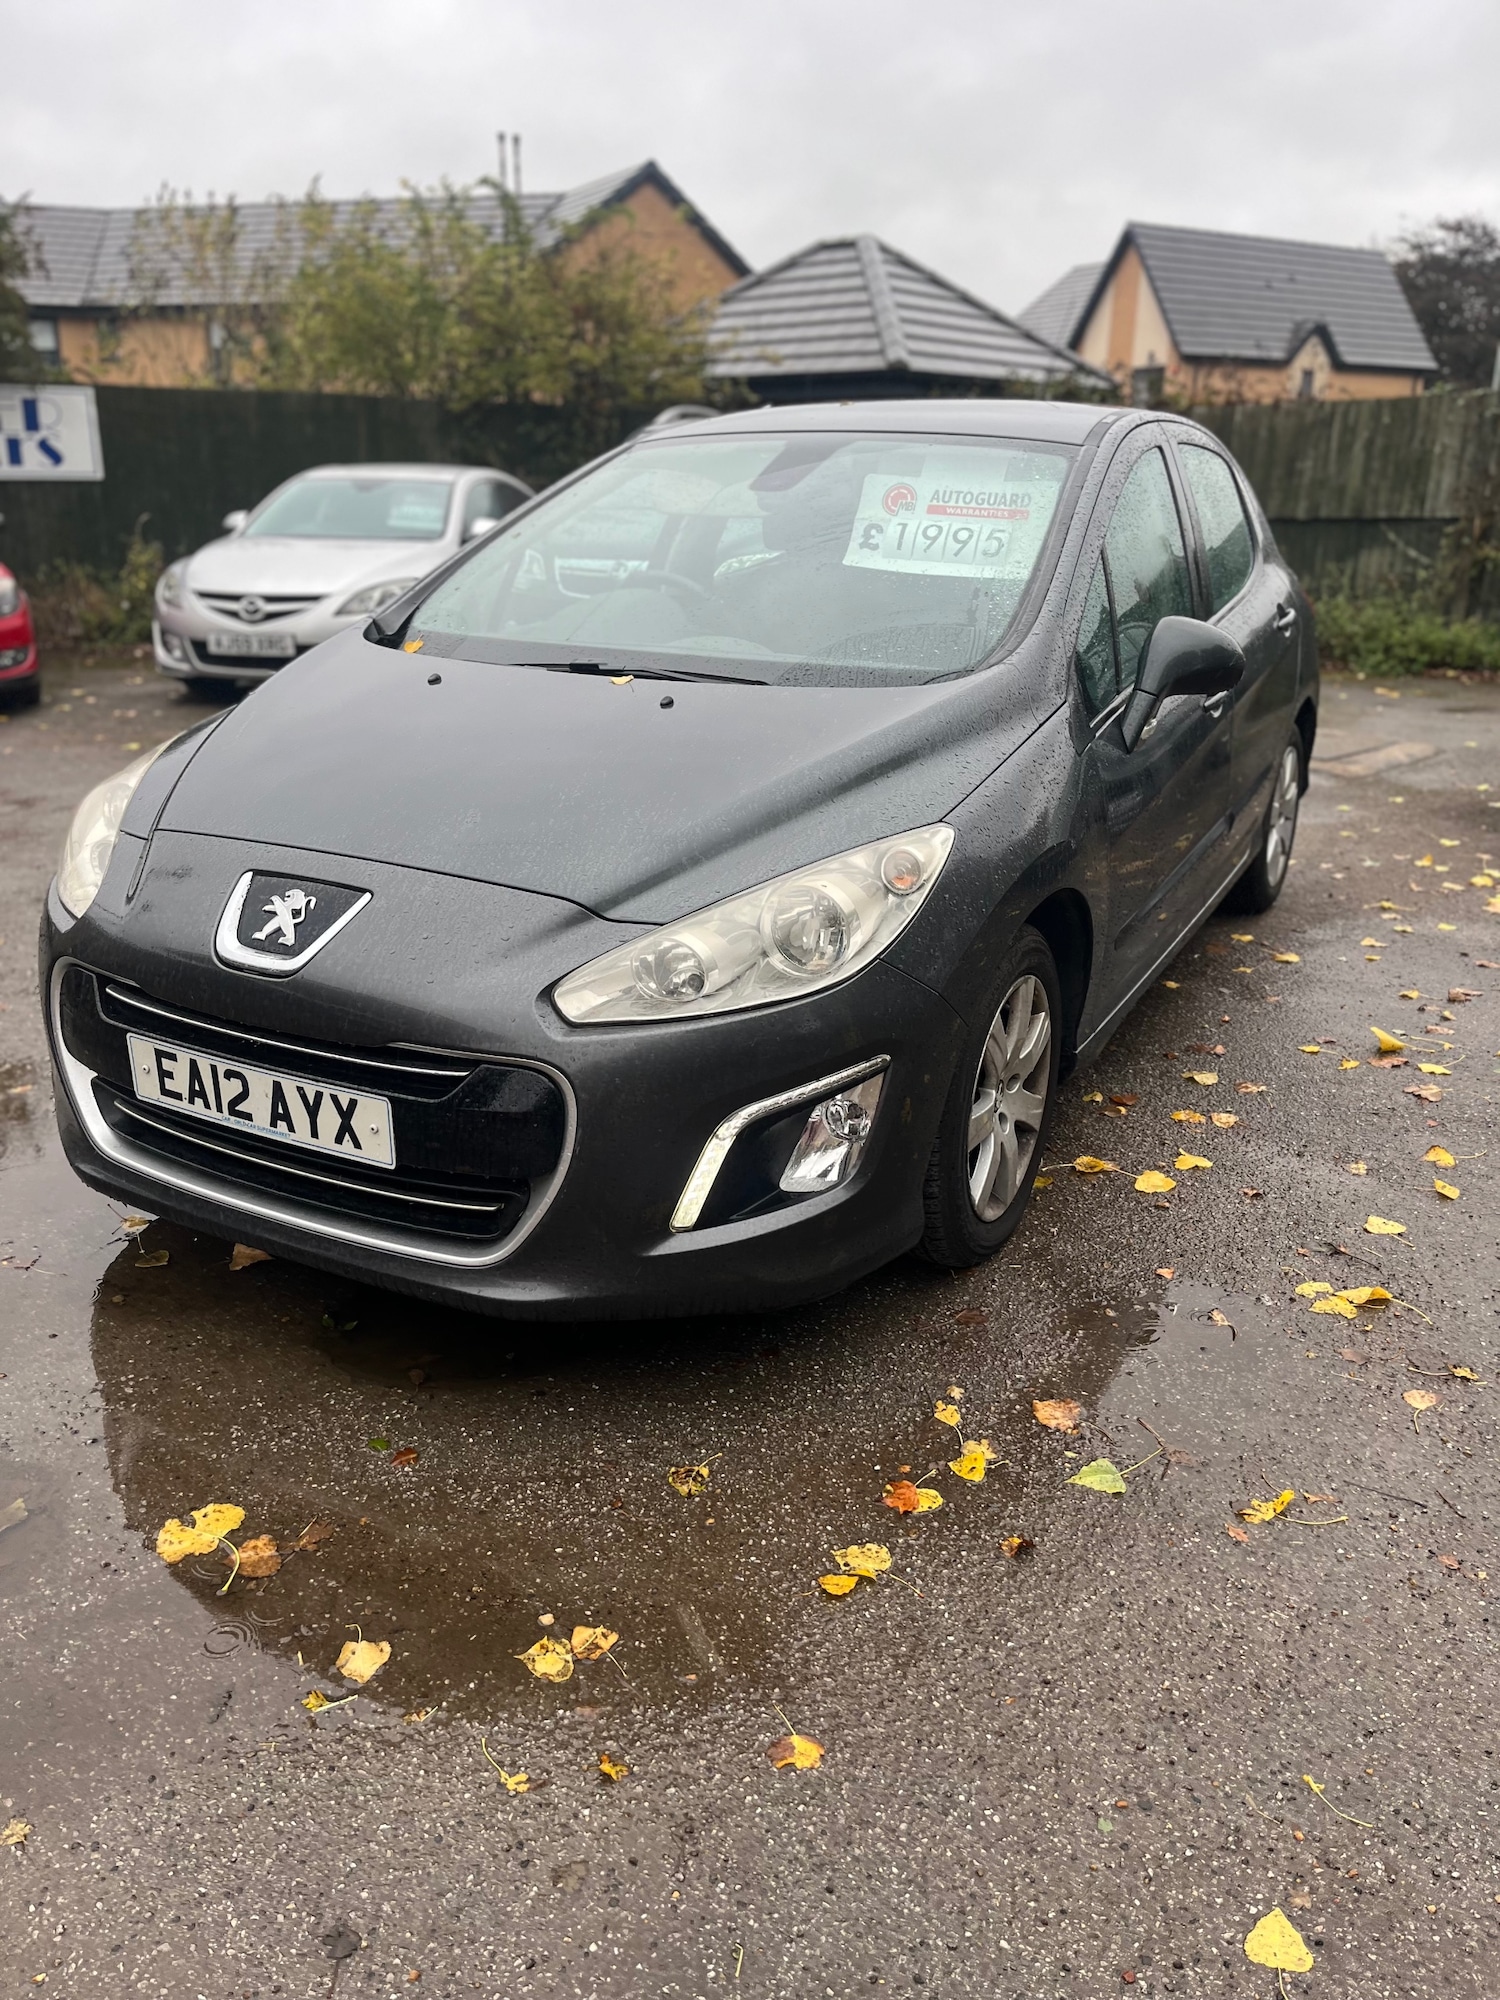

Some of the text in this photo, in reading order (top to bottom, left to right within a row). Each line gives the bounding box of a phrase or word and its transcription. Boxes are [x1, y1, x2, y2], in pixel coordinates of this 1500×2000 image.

[929, 488, 1032, 508] AUTOGUARD
[945, 506, 1009, 518] WARRANTIES
[858, 521, 1006, 558] £1995
[153, 1046, 363, 1150] EA12 AYX
